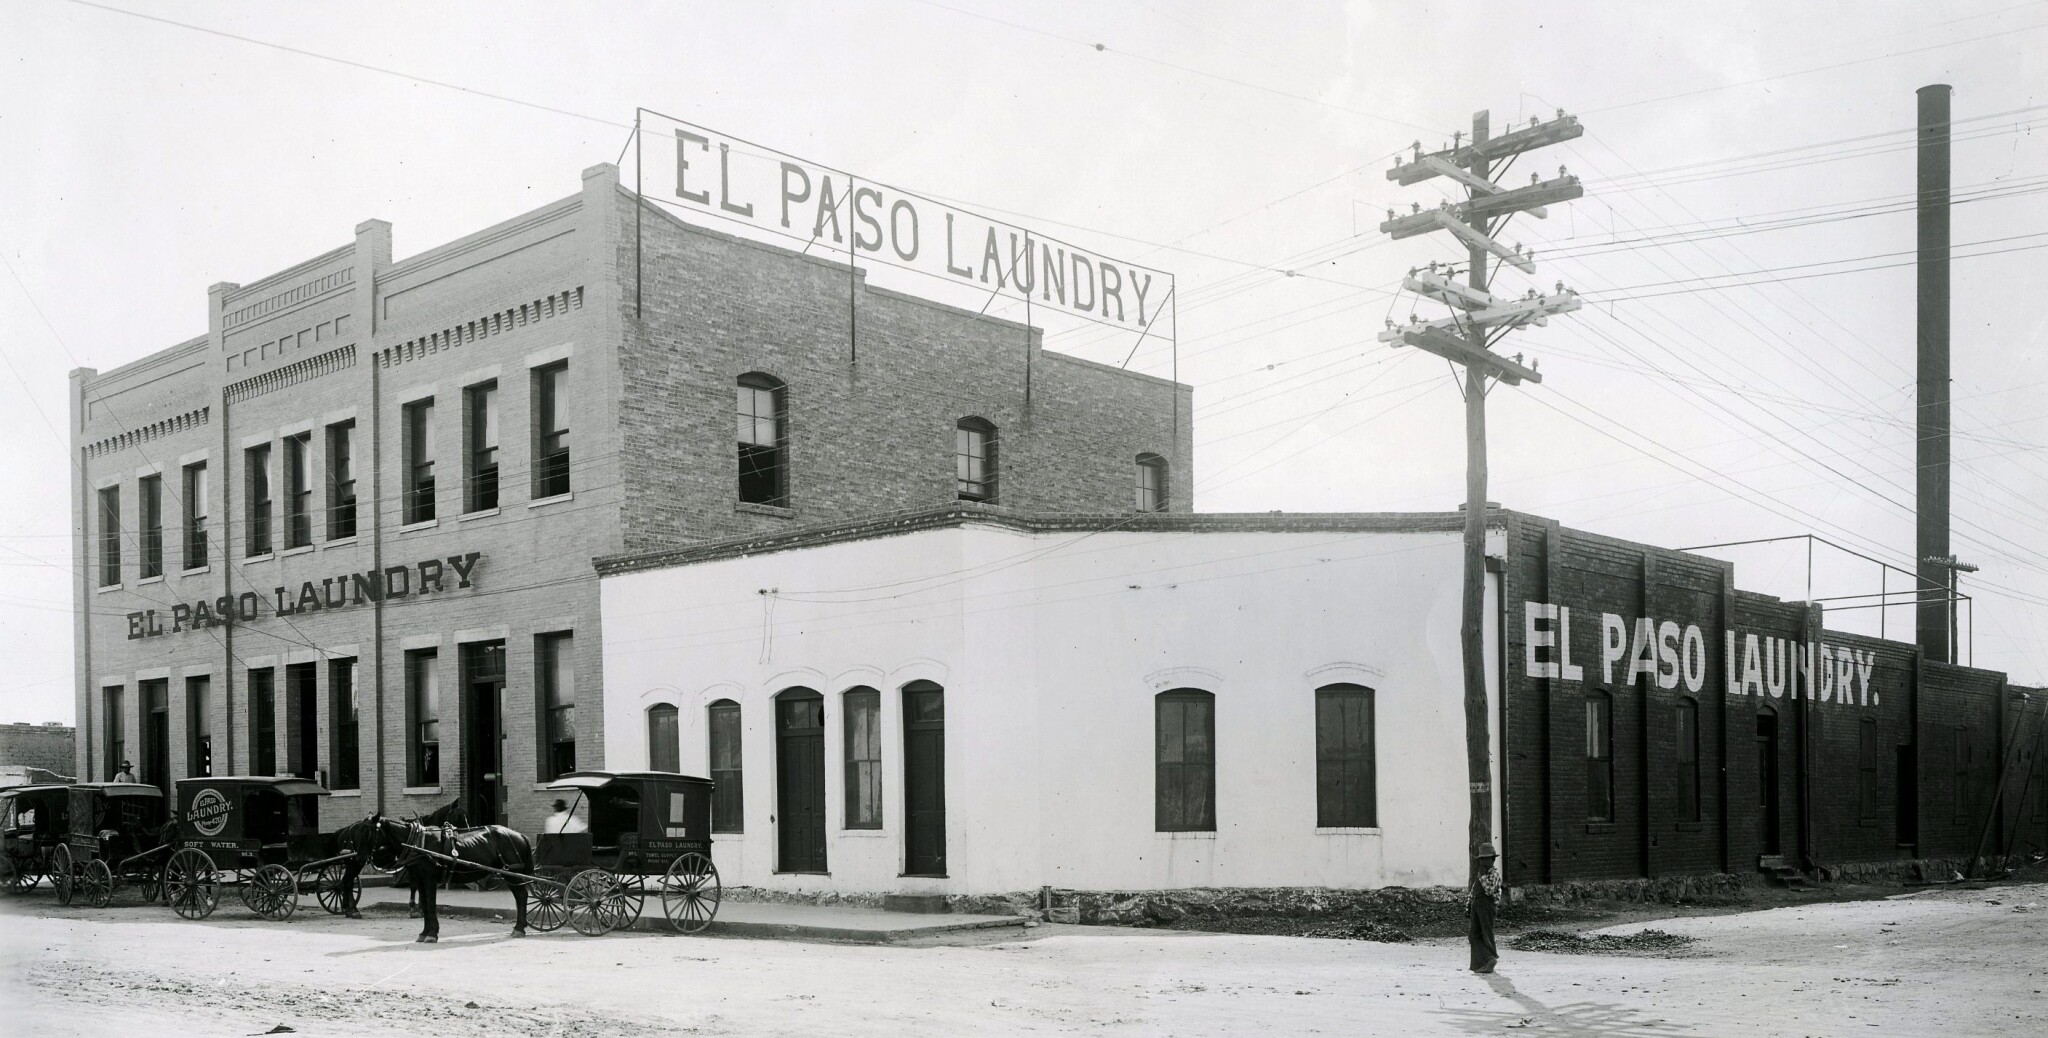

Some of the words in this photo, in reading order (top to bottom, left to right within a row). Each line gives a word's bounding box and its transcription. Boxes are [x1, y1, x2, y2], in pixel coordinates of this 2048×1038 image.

[675, 128, 753, 218] EL
[780, 161, 919, 262] PASO
[946, 213, 1152, 327] LAUNDRY
[127, 610, 163, 640] EL
[172, 591, 258, 633] PASO
[275, 551, 481, 617] LAUNDRY
[1525, 601, 1583, 681] EL
[1602, 612, 1706, 692] PASO
[1725, 629, 1880, 706] LAUNDRY.
[187, 801, 234, 821] LAUNDRY.
[210, 841, 239, 849] WATER.
